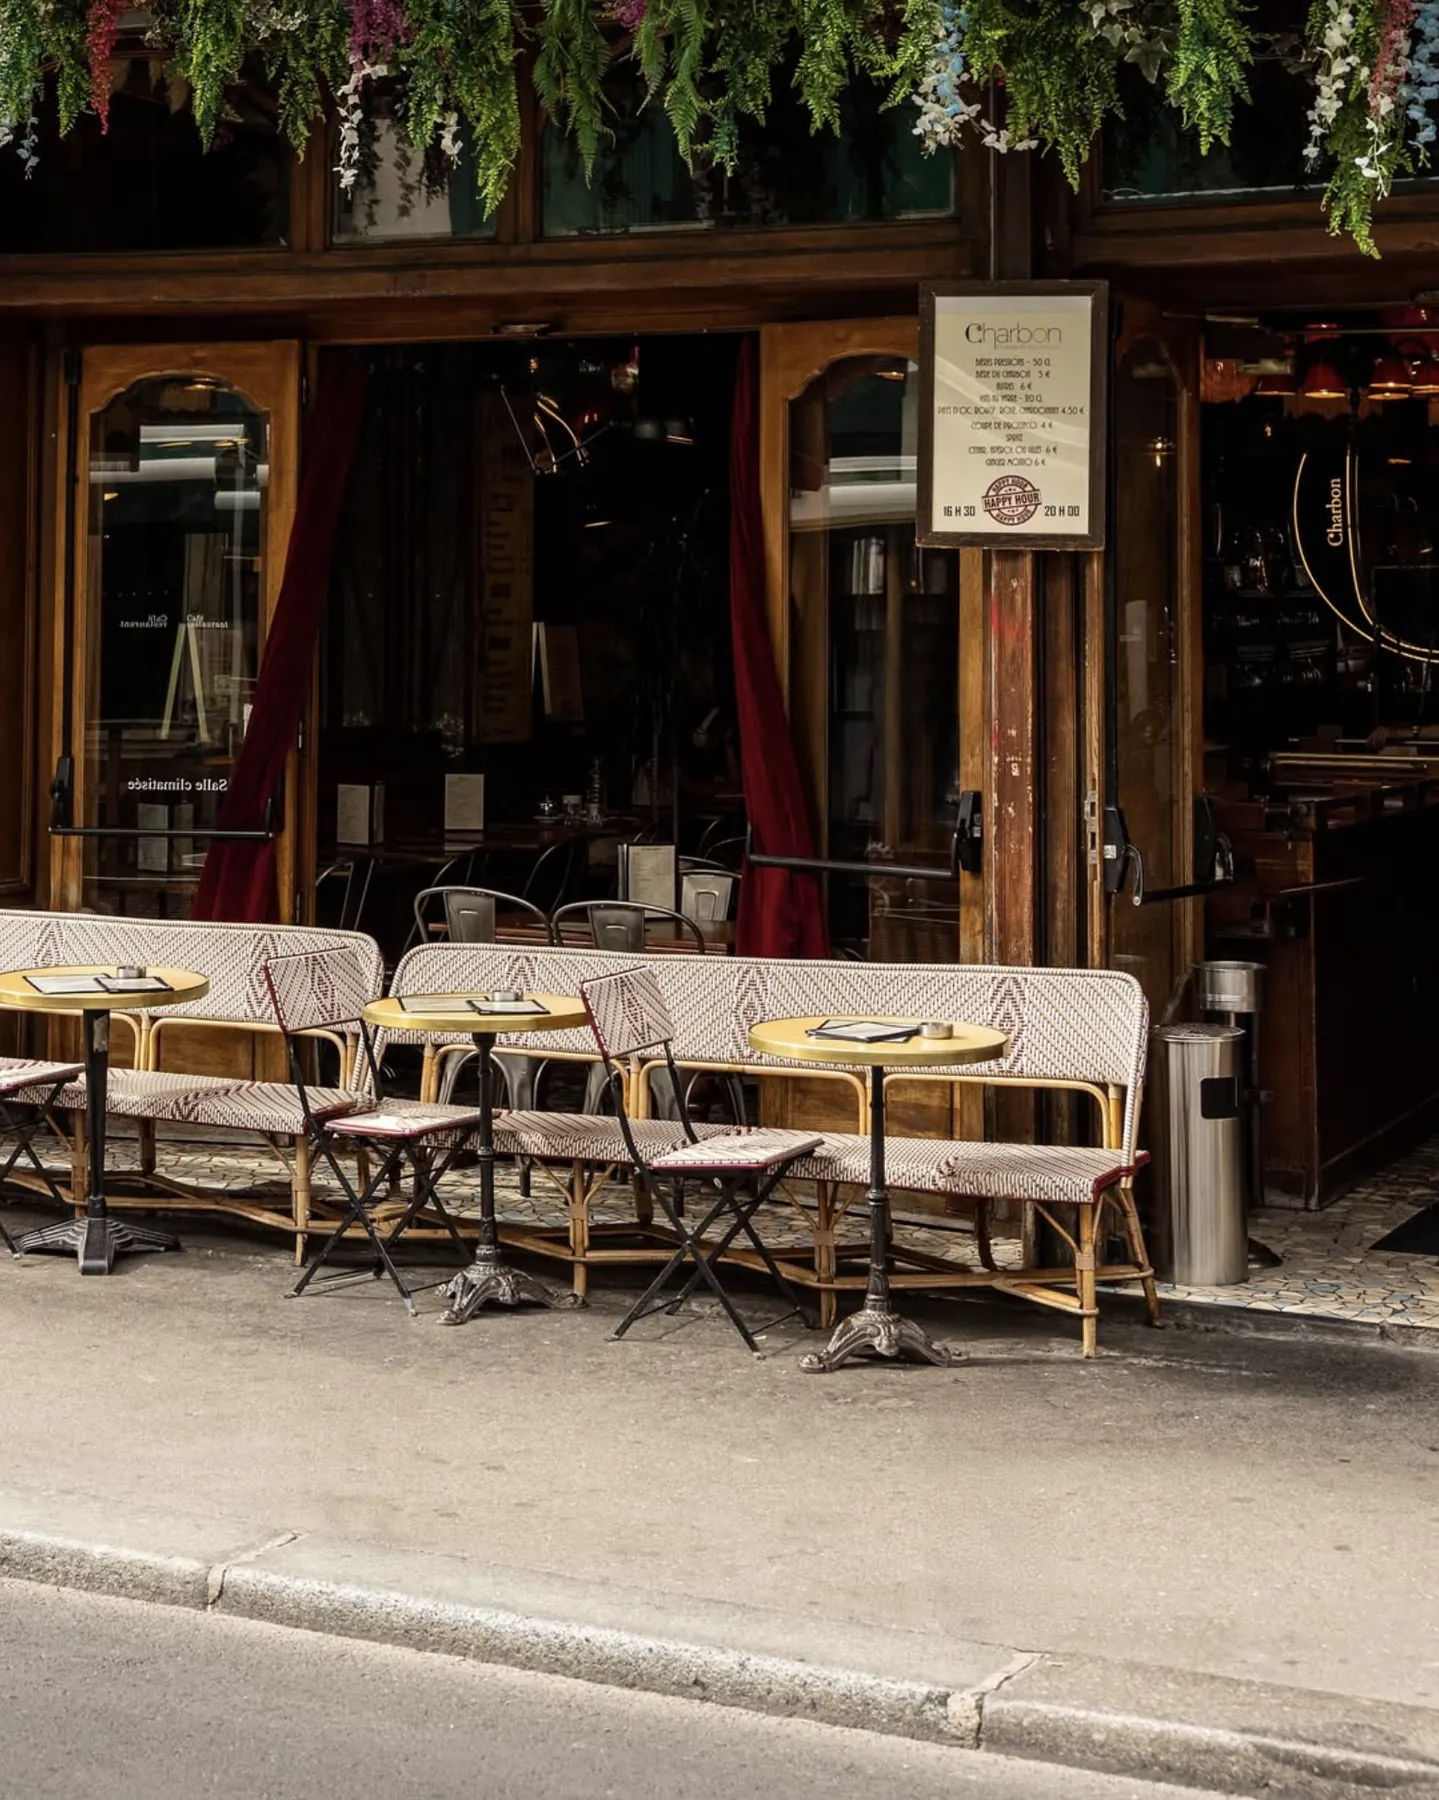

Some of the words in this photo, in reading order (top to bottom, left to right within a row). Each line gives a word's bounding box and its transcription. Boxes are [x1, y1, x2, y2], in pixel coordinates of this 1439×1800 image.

[965, 321, 1062, 351] Charbon
[1001, 369, 1031, 379] CRBON
[1045, 369, 1051, 379] €
[1019, 382, 1025, 391] 6
[1003, 421, 1037, 430] PROO
[1045, 445, 1051, 455] 6
[1052, 445, 1058, 455] €
[1007, 457, 1033, 467] MOO
[1034, 457, 1040, 467] 6
[991, 478, 1010, 493] HAPPY
[1011, 478, 1029, 489] HOUR
[984, 496, 1012, 509] HAPPY
[1015, 492, 1040, 505] HOUR
[943, 505, 953, 517] 16
[955, 505, 961, 517] H
[963, 505, 976, 517] 30
[1044, 505, 1057, 517] 20
[1059, 505, 1065, 517] H
[1067, 505, 1080, 517] 00
[1325, 477, 1343, 547] Charbon
